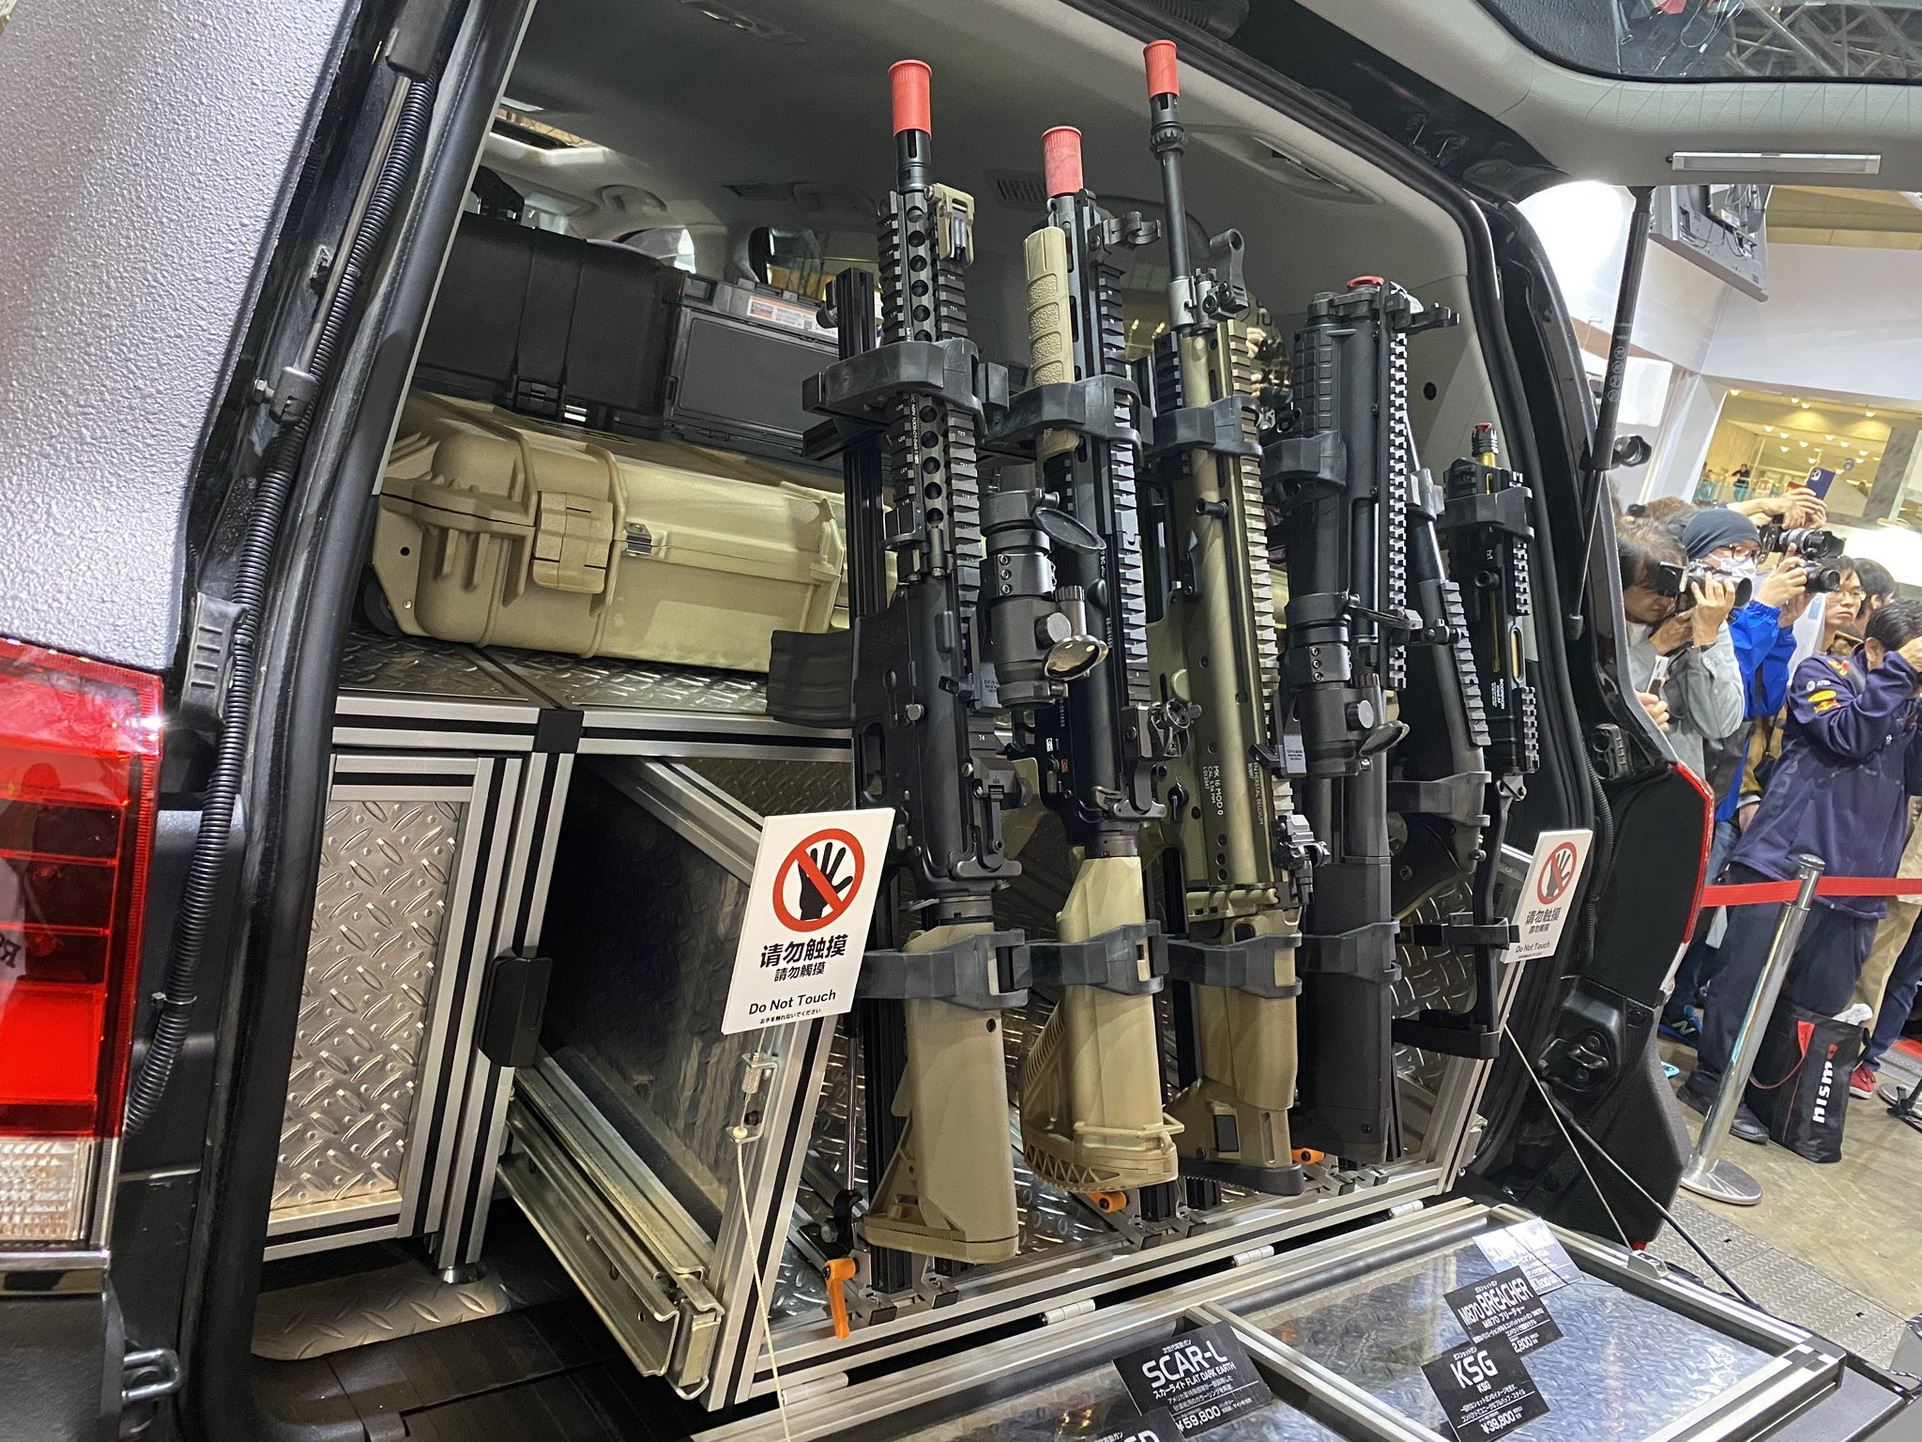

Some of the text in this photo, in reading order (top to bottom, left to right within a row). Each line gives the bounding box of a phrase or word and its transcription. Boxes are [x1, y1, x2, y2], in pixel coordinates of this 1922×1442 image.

[1215, 788, 1223, 808] MOD
[759, 934, 849, 968] 请勿触摸
[1515, 941, 1551, 953] Do Not Touch
[774, 962, 826, 982] 請勿觸摸
[749, 989, 836, 1015] Do Not Touch
[1457, 1300, 1485, 1326] M870
[1475, 1277, 1534, 1317] BREACHER
[1142, 1340, 1228, 1388] SCAR-L
[1450, 1350, 1499, 1389] KSG
[1152, 1361, 1236, 1400] スカーライト FLAT DARK EARTH
[1476, 1381, 1491, 1393] KSG
